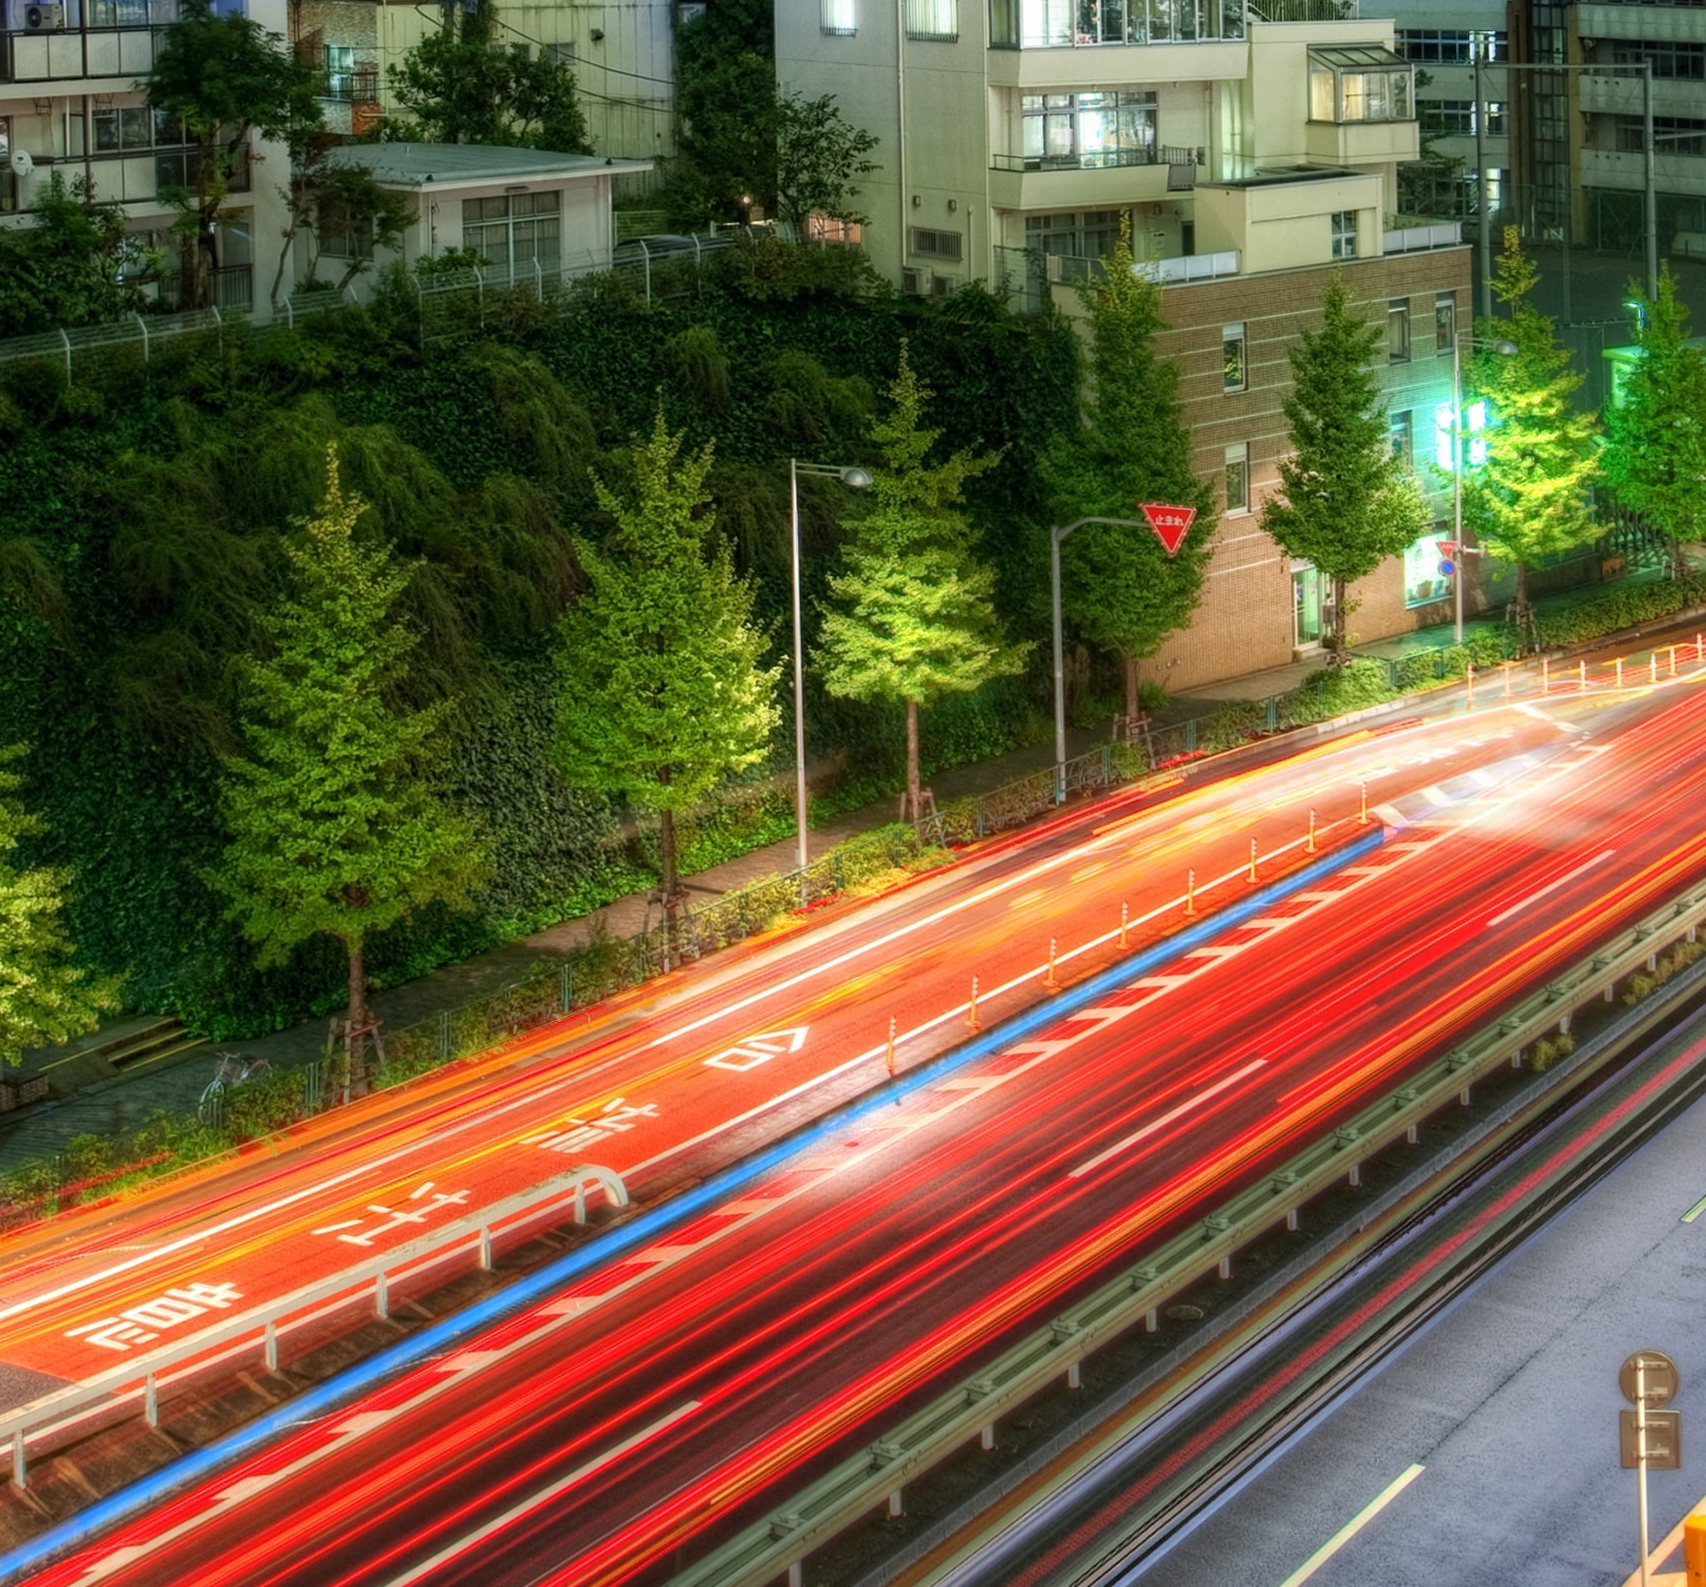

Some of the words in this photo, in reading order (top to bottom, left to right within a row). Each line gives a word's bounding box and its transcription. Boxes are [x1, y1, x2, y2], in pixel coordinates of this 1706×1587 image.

[1155, 514, 1185, 526] 止まれ
[64, 1026, 811, 1352] 合流注意
